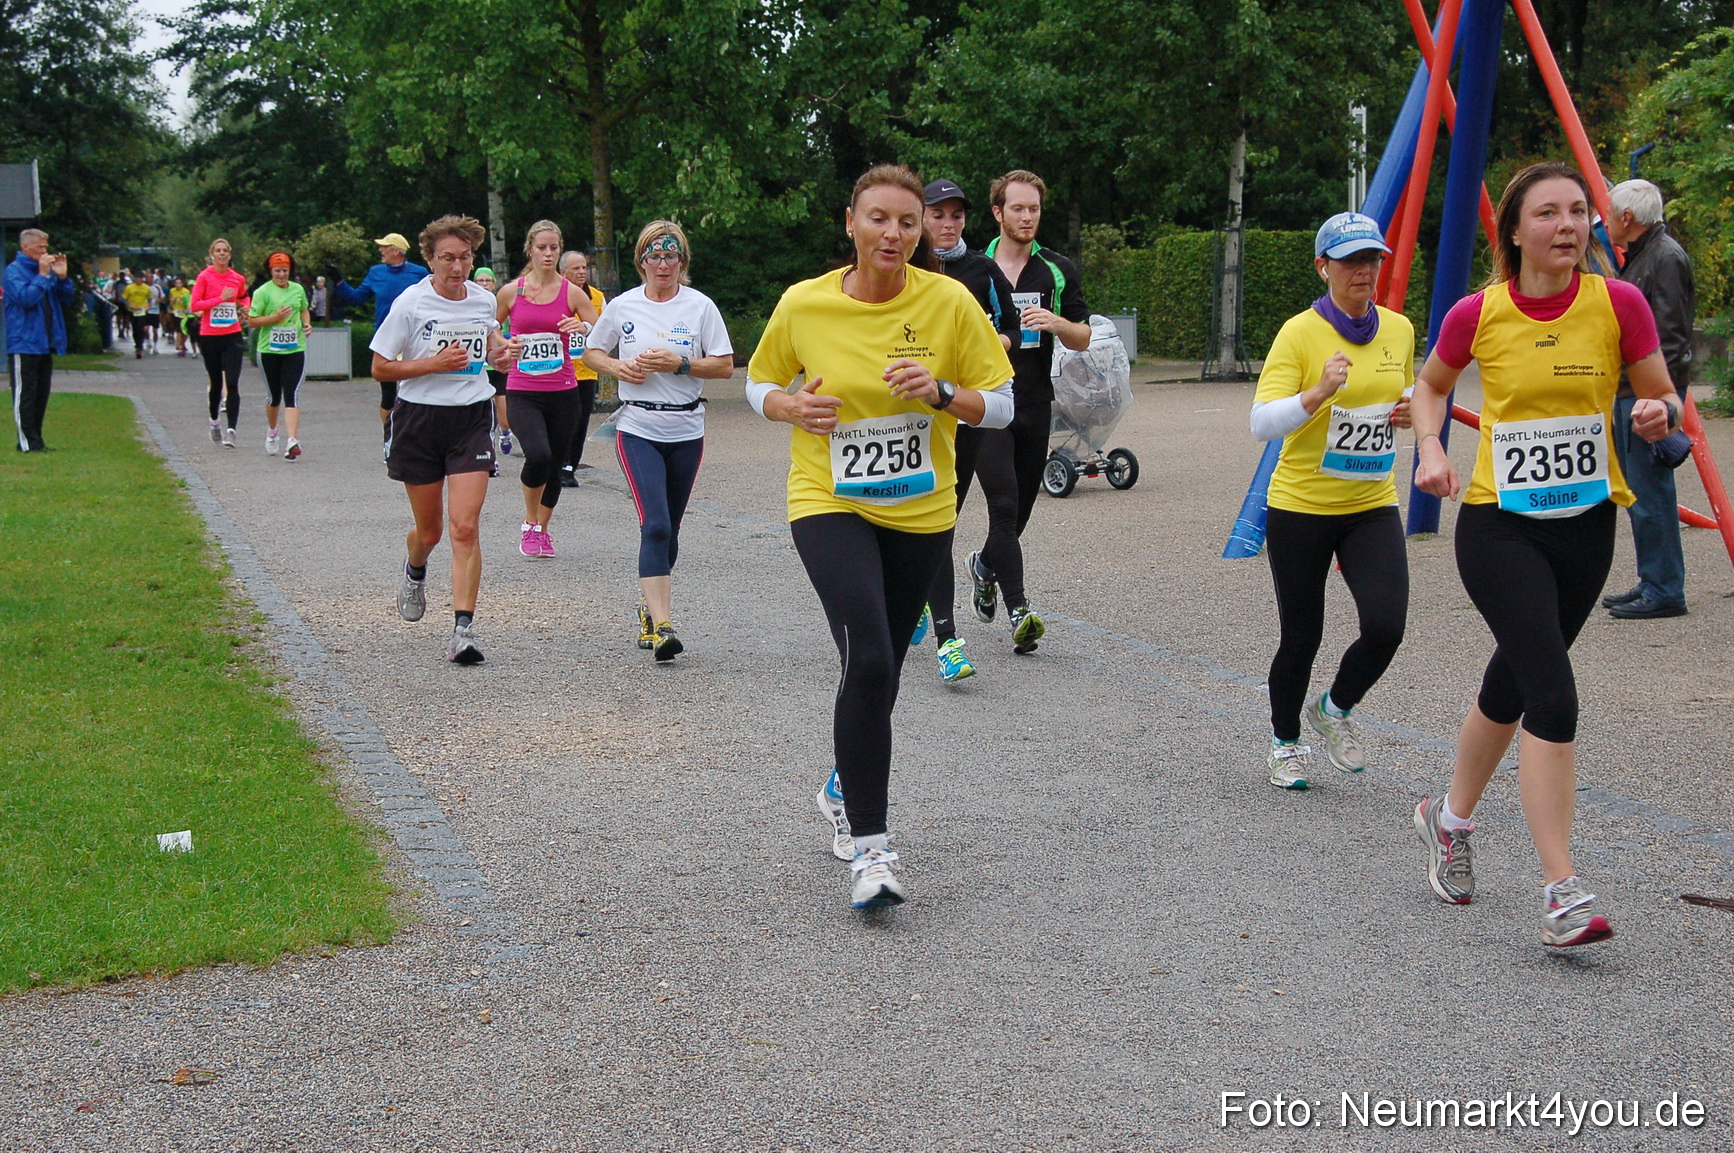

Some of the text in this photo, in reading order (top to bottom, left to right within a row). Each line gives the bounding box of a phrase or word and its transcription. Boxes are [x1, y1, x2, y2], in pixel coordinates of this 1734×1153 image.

[213, 308, 234, 318] 2357
[272, 332, 296, 343] 2039
[433, 329, 453, 337] PARTL
[570, 336, 584, 348] 59
[1535, 340, 1556, 348] PUMA
[521, 343, 559, 360] 2494
[832, 422, 914, 441] PARTL Neumarkt
[1335, 421, 1394, 452] 2259
[1494, 426, 1587, 443] PARTL Neumarkt
[842, 434, 922, 479] 2258
[1344, 458, 1383, 470] Silvana
[1505, 439, 1597, 484] 2358
[862, 483, 909, 497] Kerstin
[1529, 491, 1579, 508] Sabine
